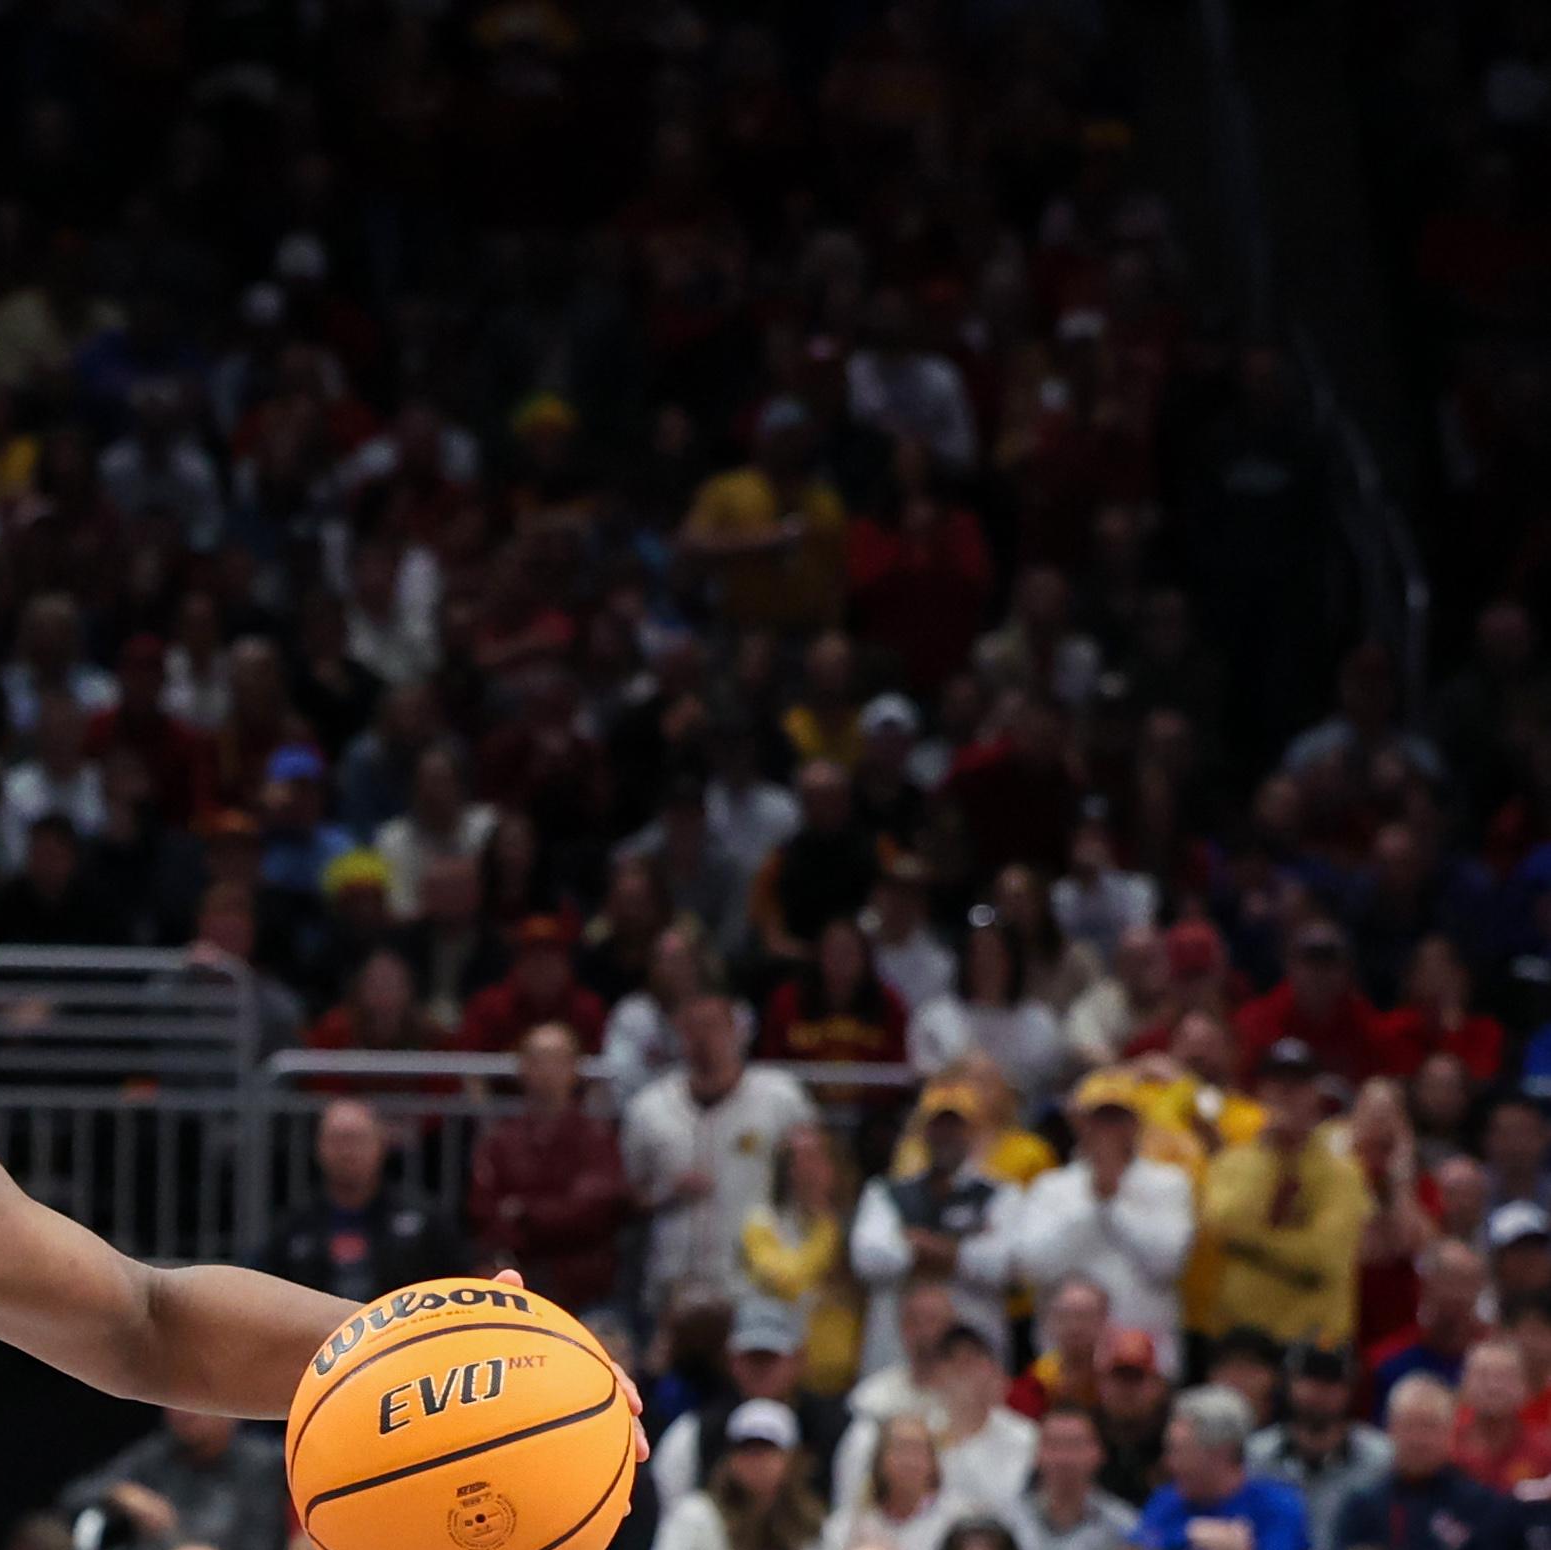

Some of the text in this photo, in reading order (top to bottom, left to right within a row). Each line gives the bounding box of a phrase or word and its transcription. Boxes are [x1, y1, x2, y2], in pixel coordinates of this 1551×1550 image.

[310, 1287, 533, 1377] Wilson
[378, 1355, 548, 1436] EVO NXT
